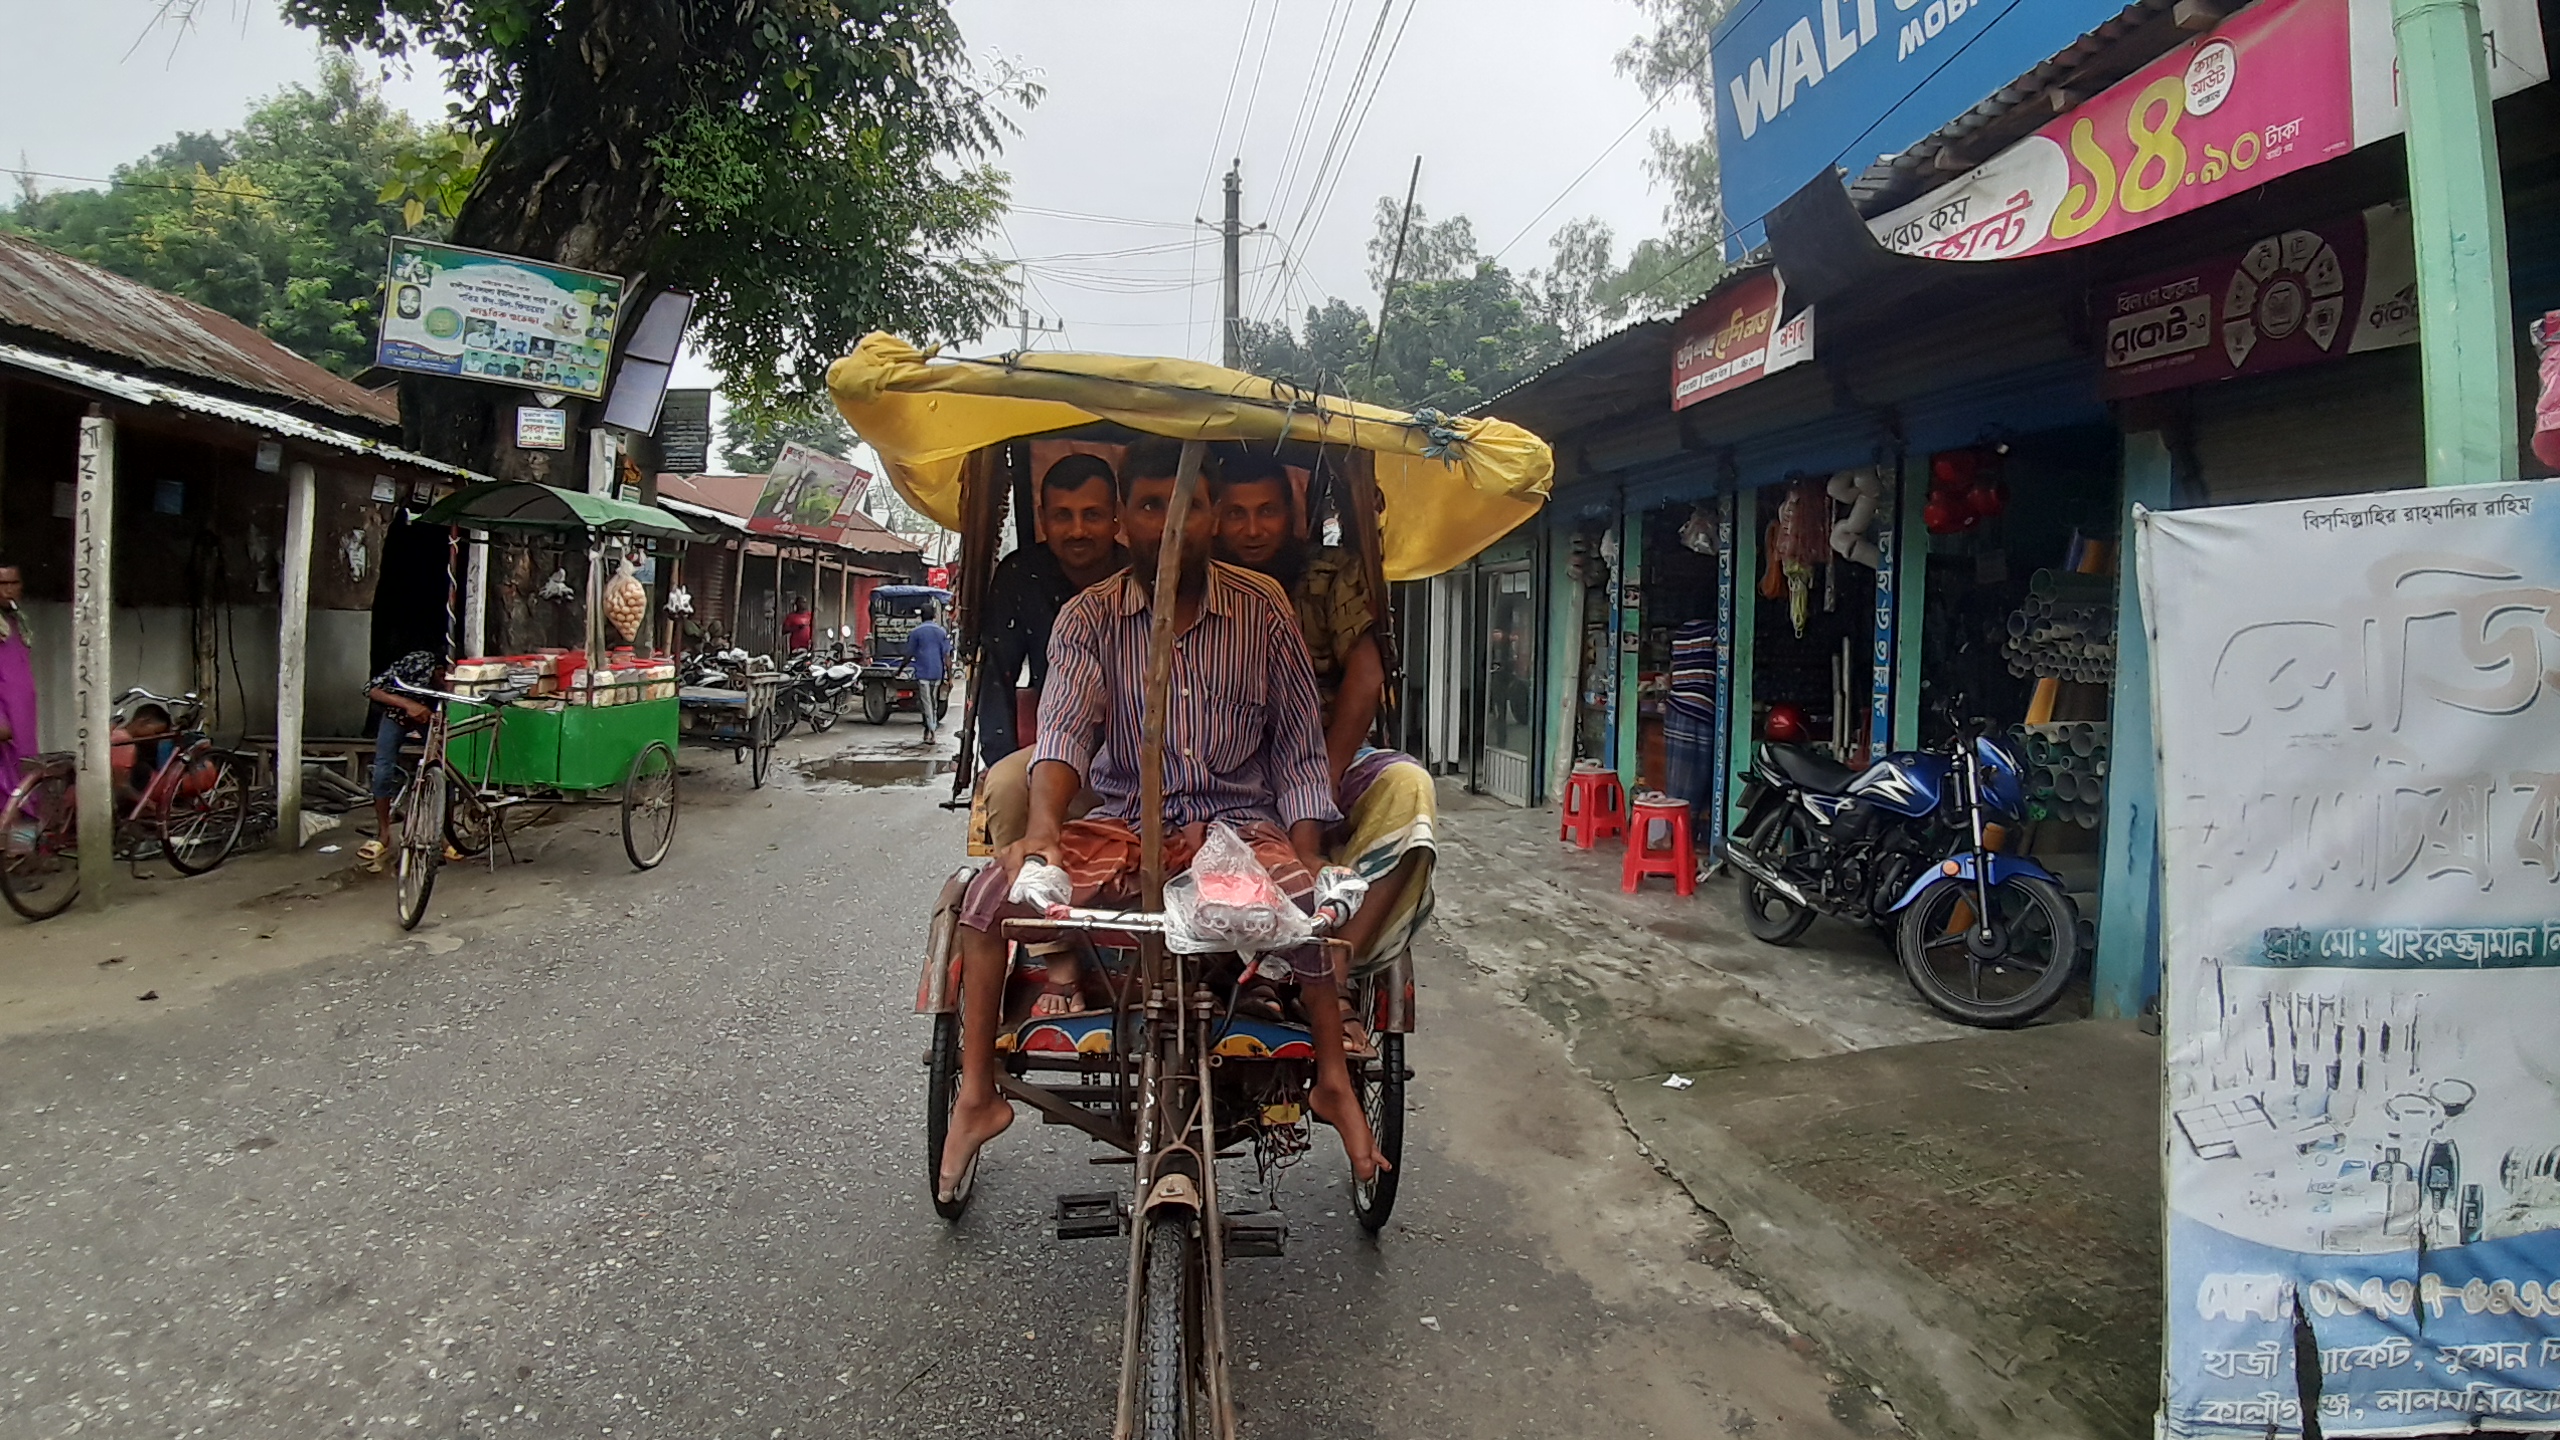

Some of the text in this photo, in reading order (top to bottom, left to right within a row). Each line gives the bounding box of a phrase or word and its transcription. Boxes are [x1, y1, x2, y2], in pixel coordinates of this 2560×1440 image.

[1898, 0, 1978, 62] MOB
[1729, 0, 1920, 141] WALT
[2193, 47, 2226, 74] ক্যাশ
[2190, 64, 2227, 96] আউট
[2264, 117, 2304, 148] টাকা
[2051, 76, 2261, 240] ১৪.৯০
[1928, 196, 1972, 231] কম
[2483, 493, 2533, 517] রাহিম
[2202, 1341, 2283, 1381] হাজী
[2376, 1382, 2560, 1417] লালমনিরহা
